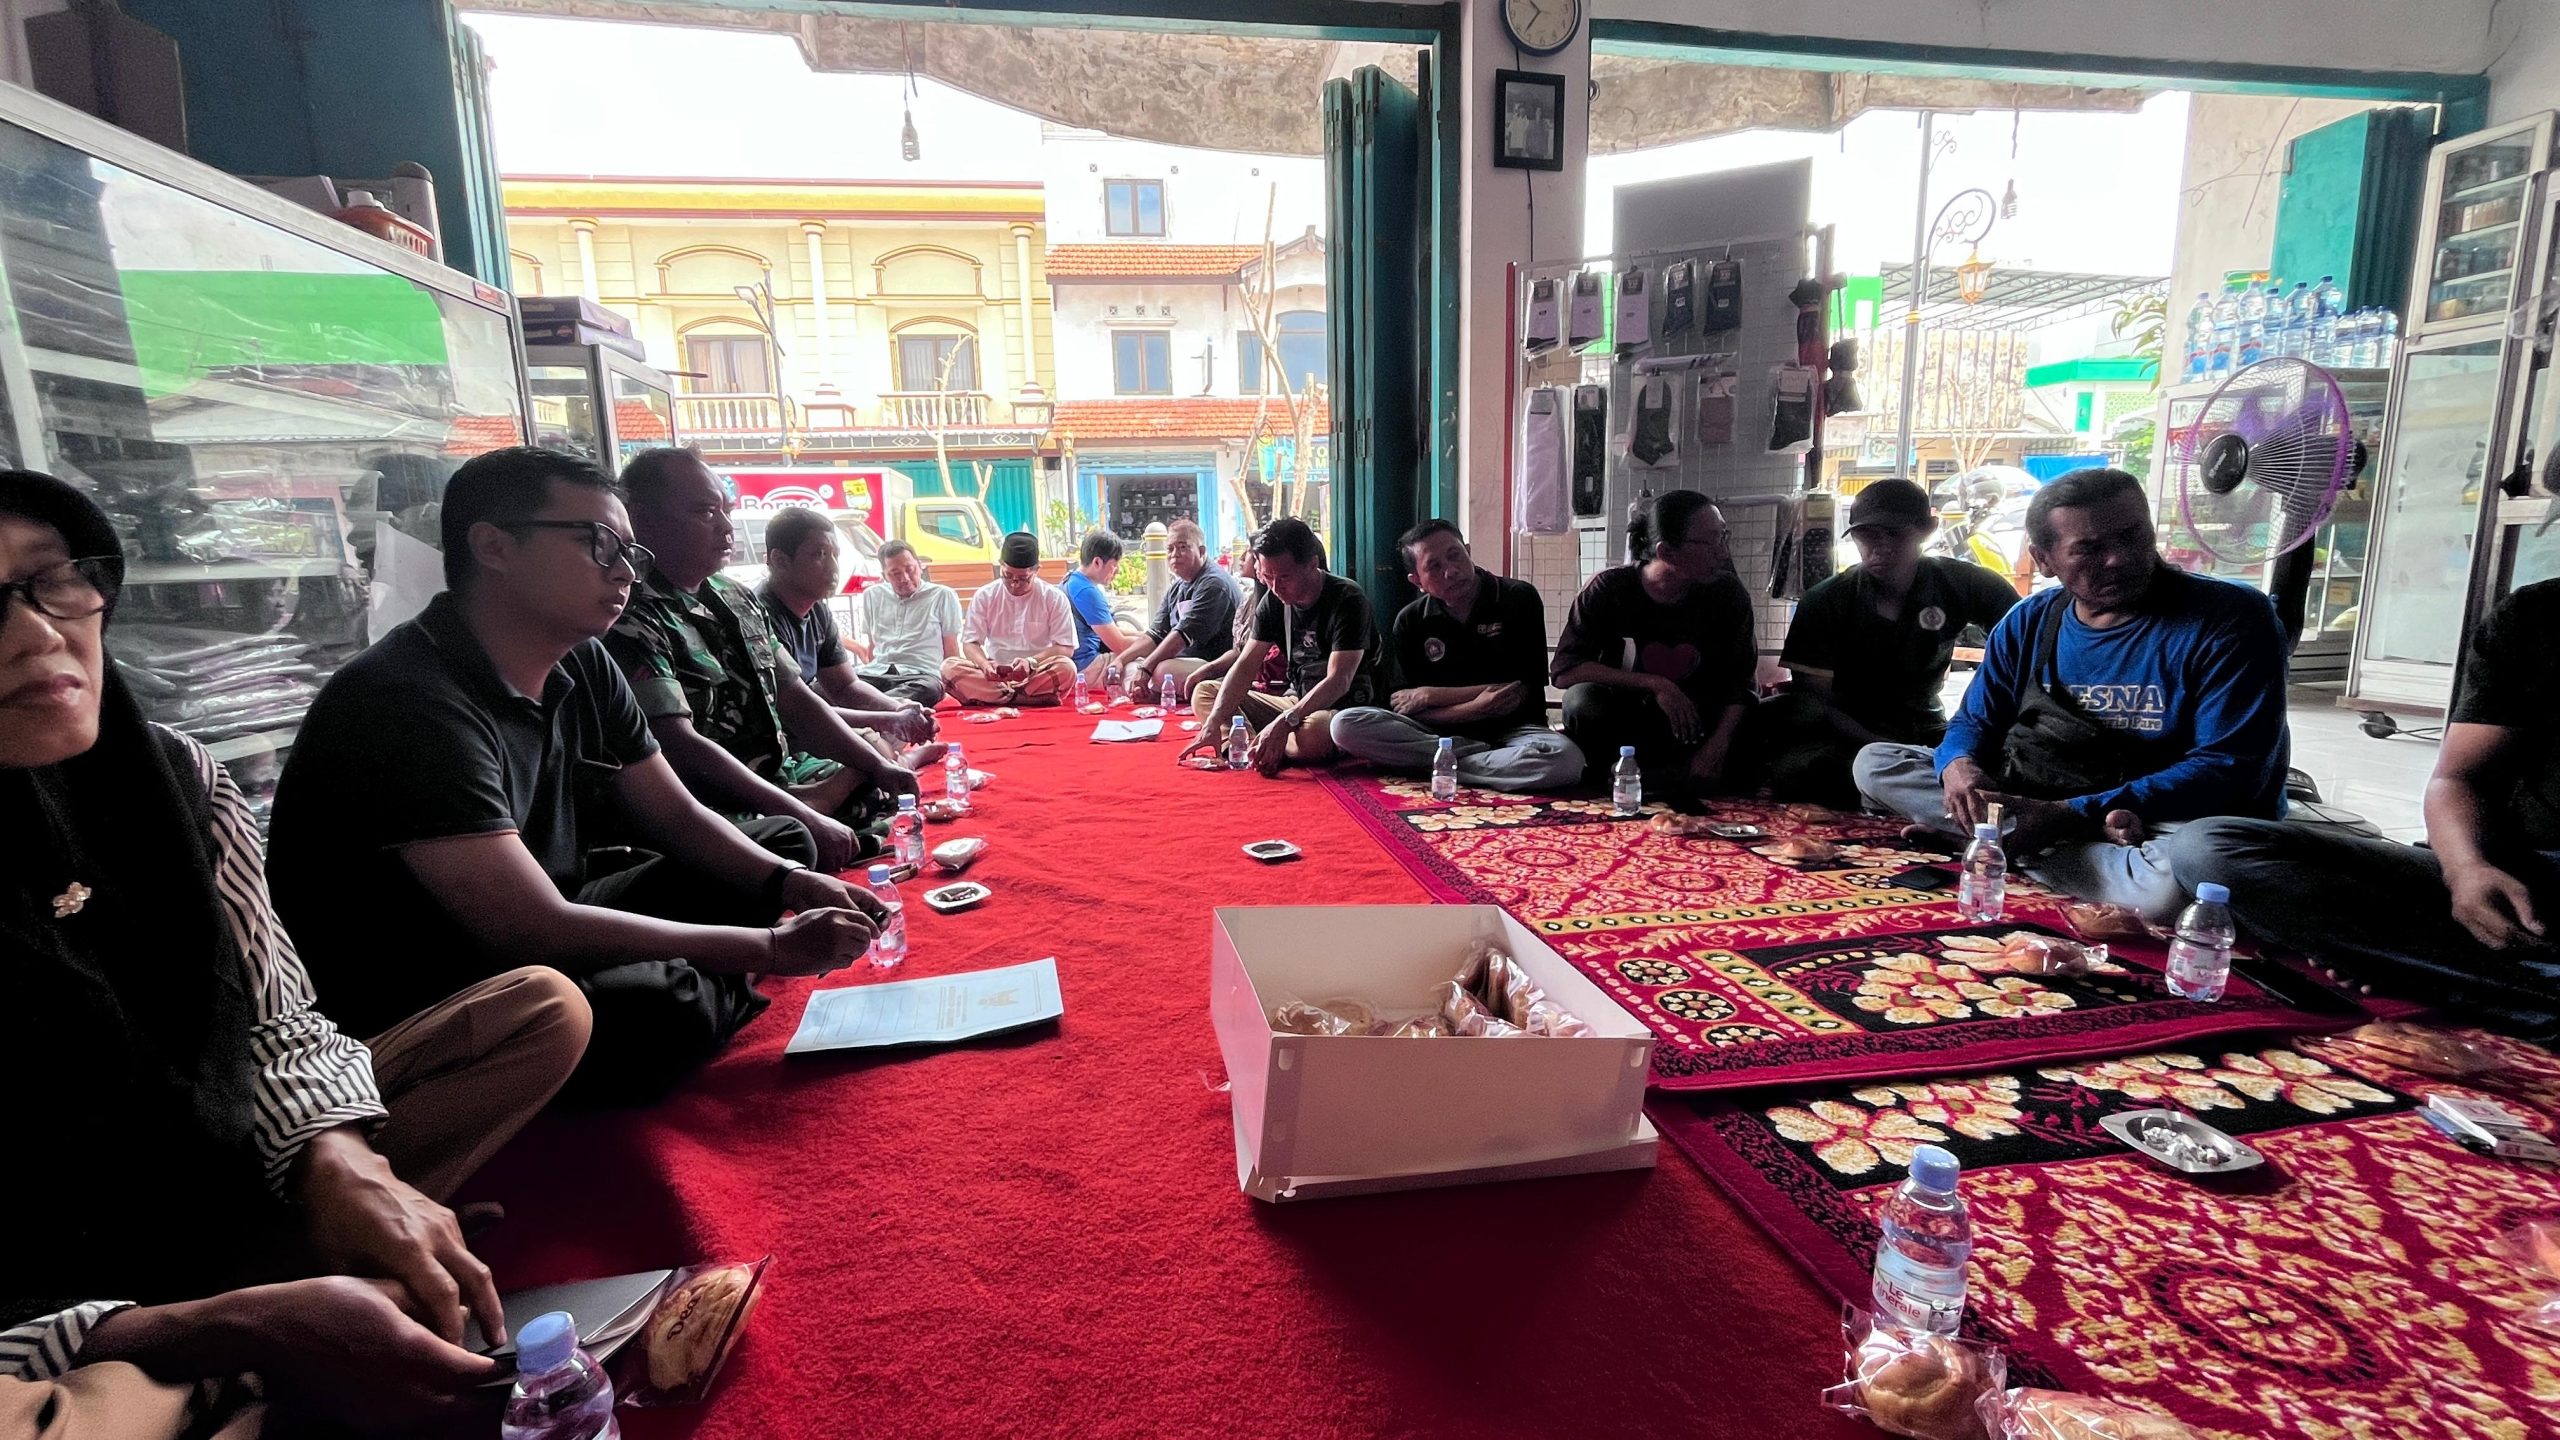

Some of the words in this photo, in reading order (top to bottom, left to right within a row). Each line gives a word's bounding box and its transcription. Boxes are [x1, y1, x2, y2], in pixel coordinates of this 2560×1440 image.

[2043, 684, 2165, 712] ESNA
[2131, 715, 2163, 730] Pare
[1889, 1281, 1904, 1301] Le
